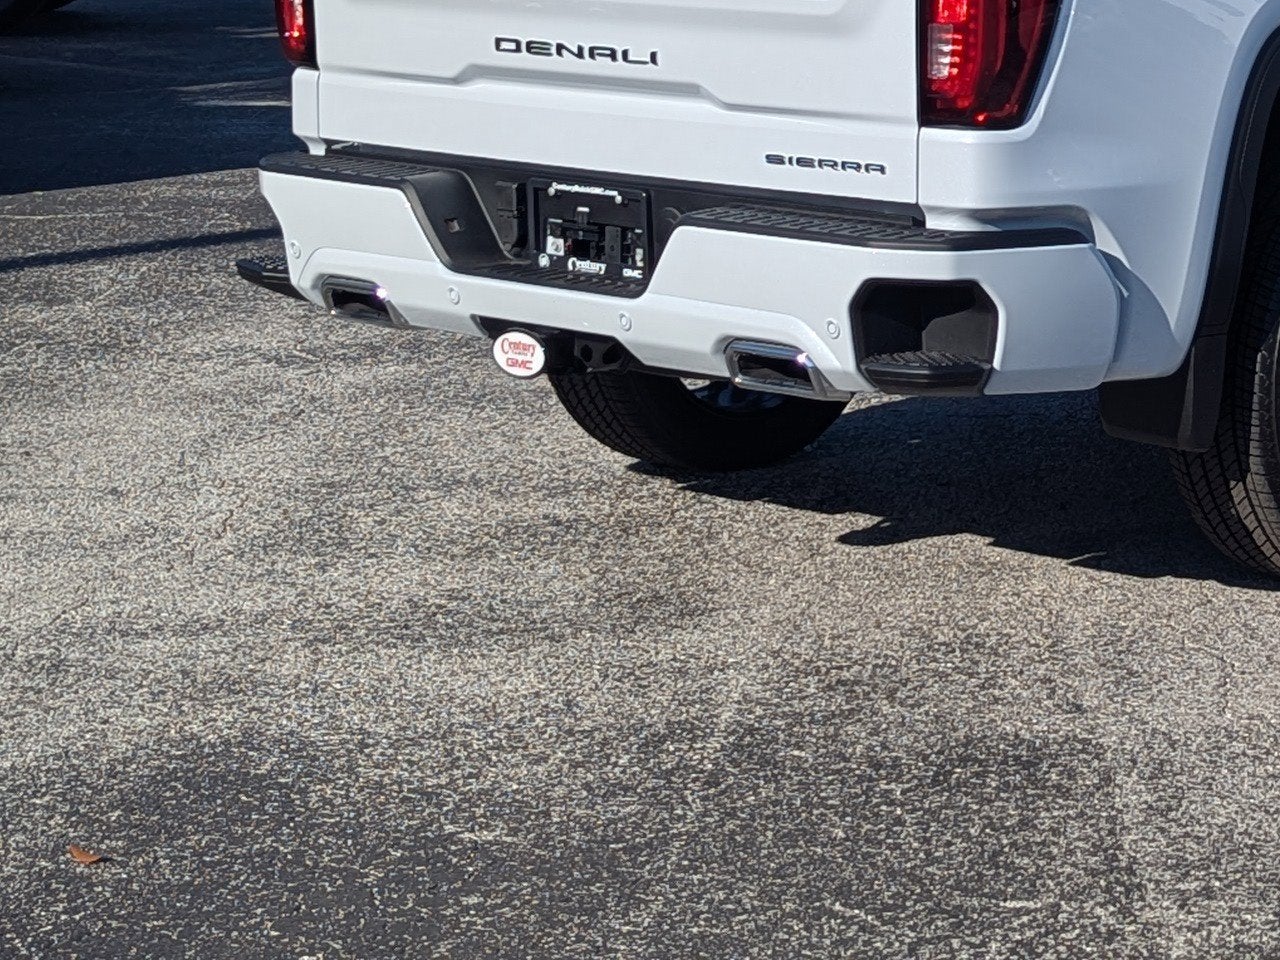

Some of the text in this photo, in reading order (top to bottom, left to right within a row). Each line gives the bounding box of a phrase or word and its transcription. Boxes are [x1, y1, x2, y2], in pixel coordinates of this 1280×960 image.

[494, 36, 659, 66] DENALI
[764, 153, 887, 175] SIERRA
[622, 267, 643, 279] GMC
[501, 337, 537, 357] Century
[506, 357, 533, 370] GMC
